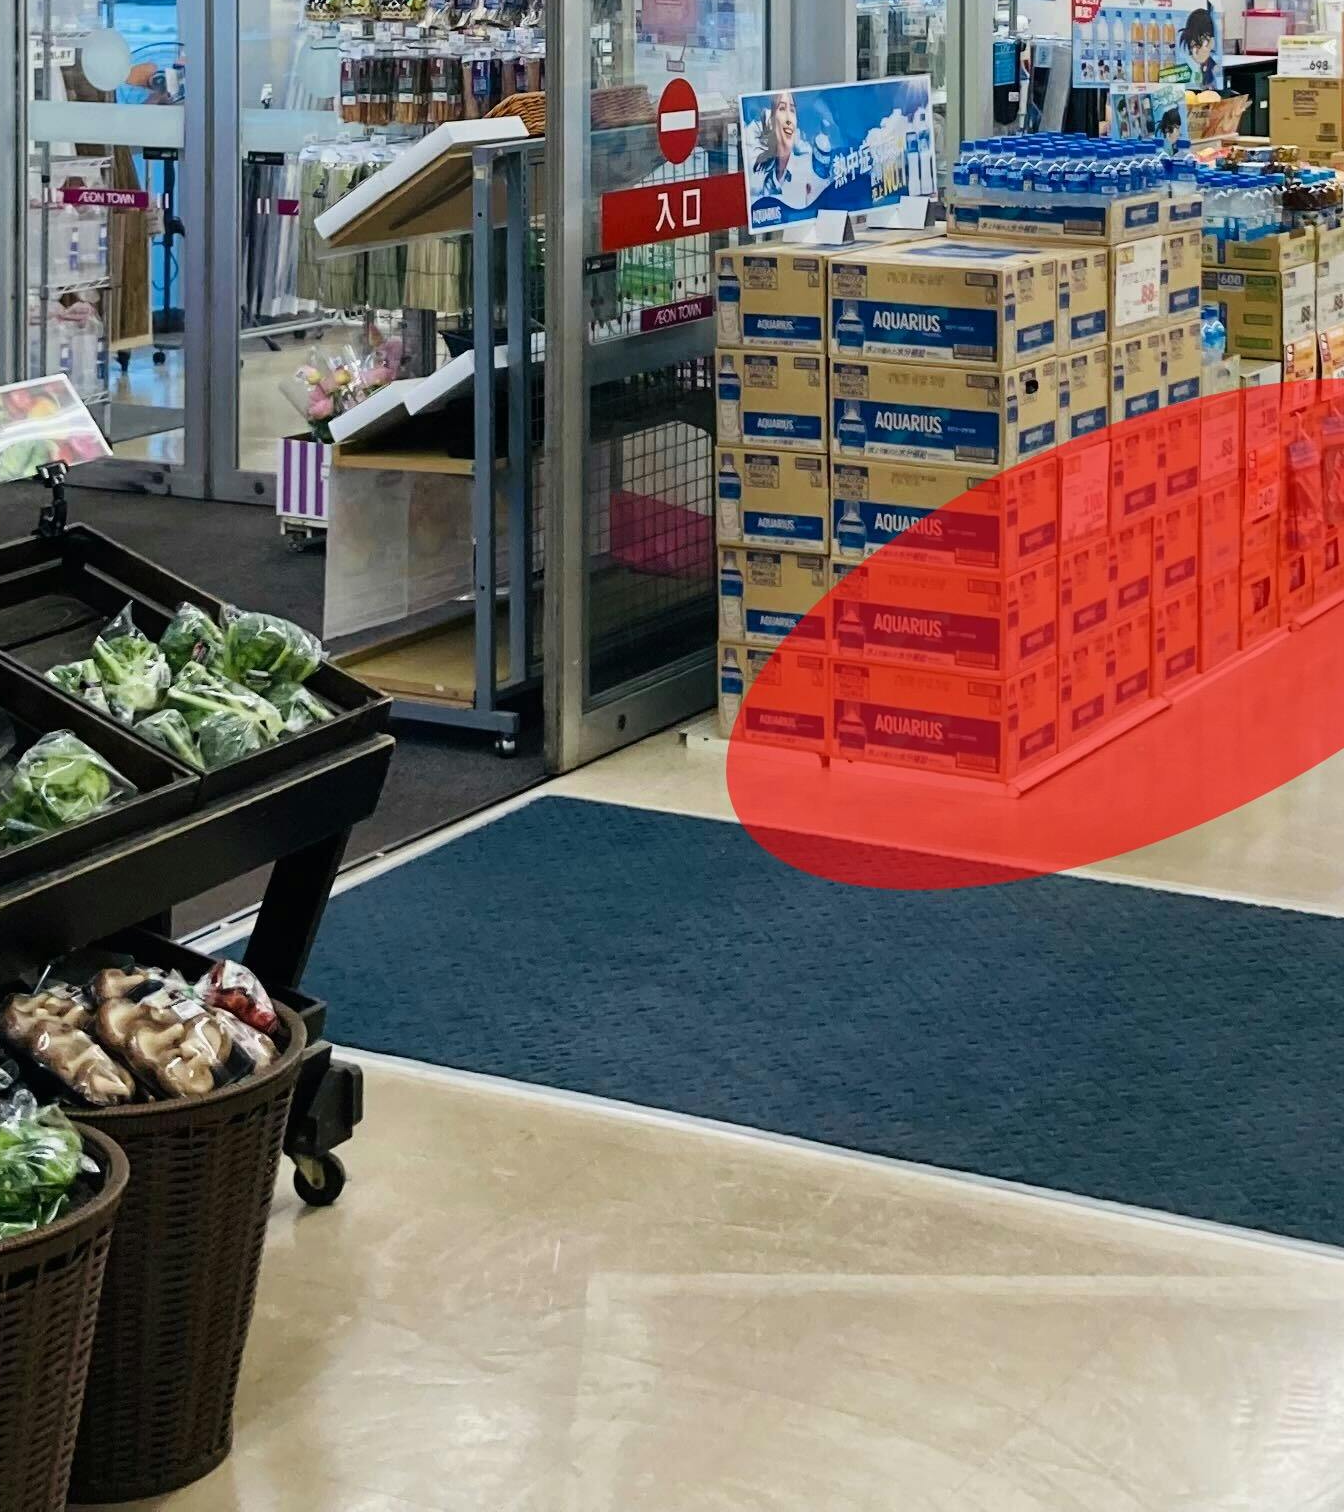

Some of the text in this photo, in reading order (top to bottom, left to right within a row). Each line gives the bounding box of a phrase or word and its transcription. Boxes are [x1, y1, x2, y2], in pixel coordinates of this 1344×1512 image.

[1308, 60, 1329, 71] 698
[107, 193, 135, 205] TOWN
[656, 188, 702, 233] 入口
[678, 302, 702, 319] TOWN
[872, 310, 942, 333] AQUARIUS
[757, 319, 795, 331] AQUARIUS
[874, 410, 944, 435] AQUARIUS
[874, 512, 943, 537] AQUARIUS
[873, 613, 942, 637] AQUARIUS
[874, 714, 943, 739] AQUARIUS
